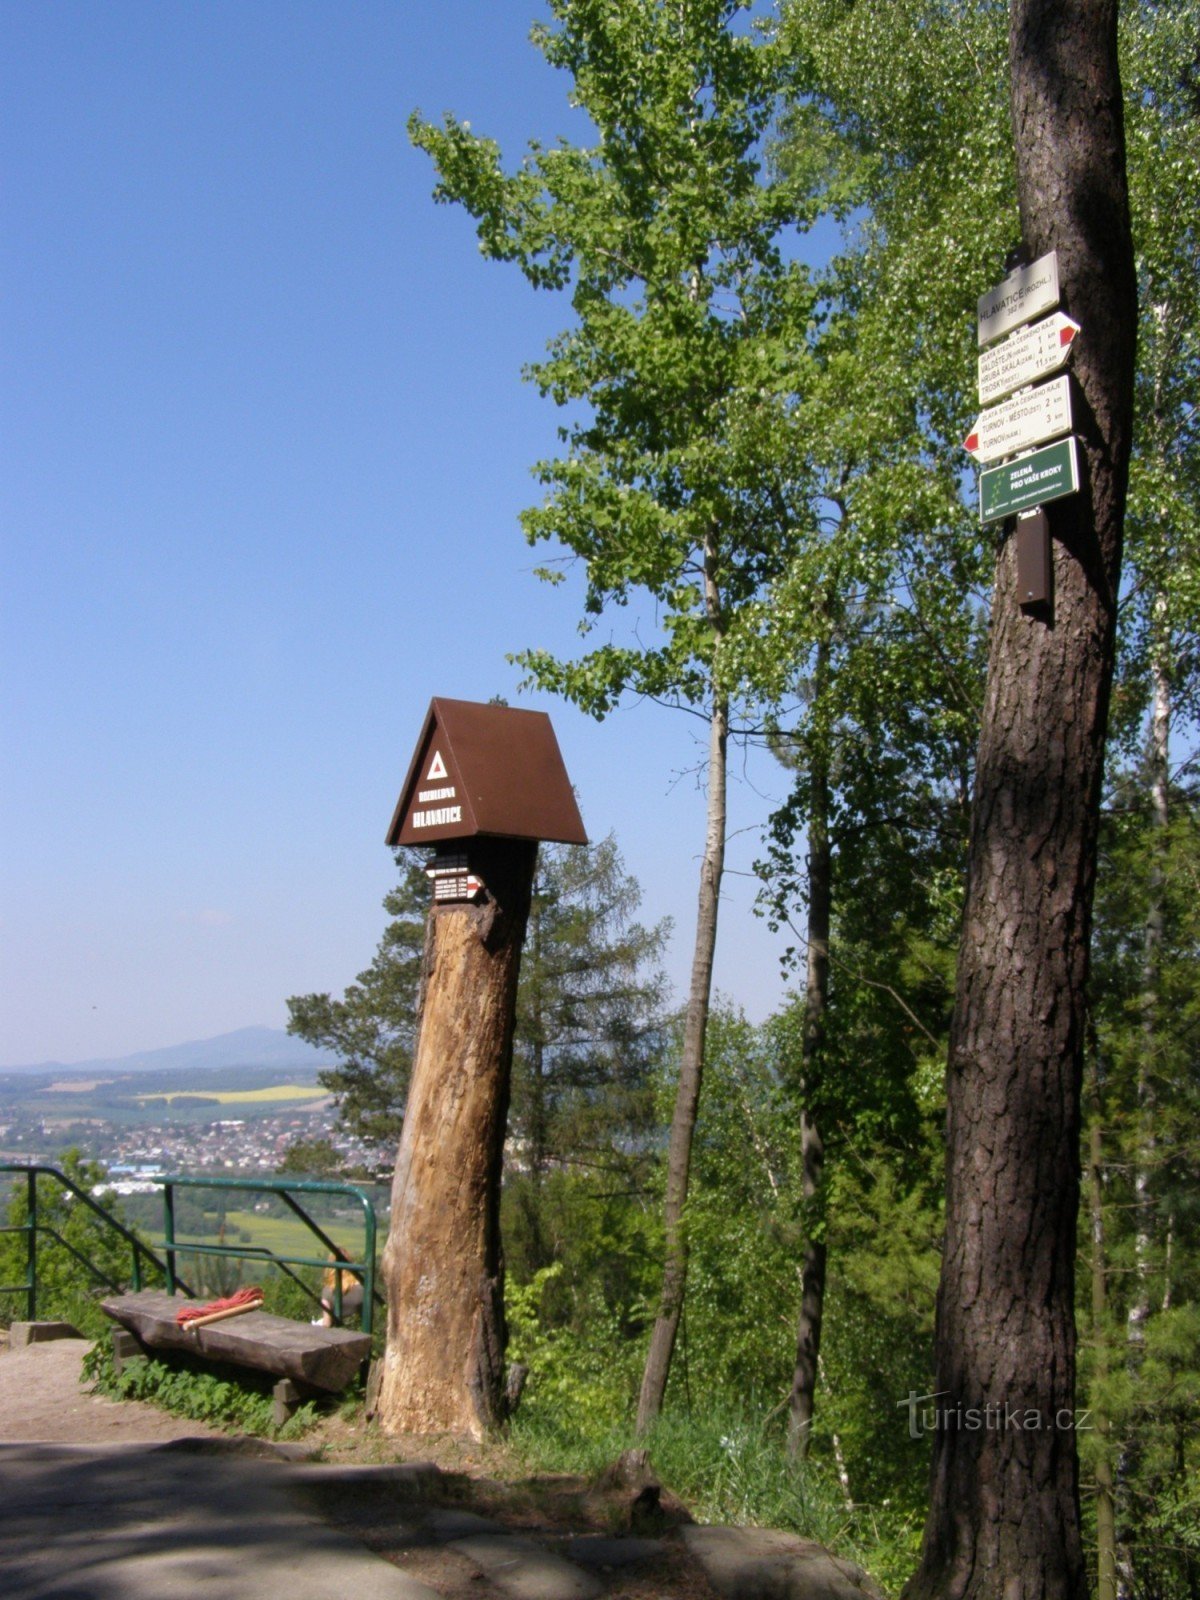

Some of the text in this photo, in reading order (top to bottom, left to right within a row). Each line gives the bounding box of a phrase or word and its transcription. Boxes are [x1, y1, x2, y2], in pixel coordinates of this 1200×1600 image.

[980, 288, 1024, 322] HLAVATICE
[982, 417, 1004, 434] TURNOV
[1045, 398, 1050, 408] 2
[983, 433, 1005, 449] TURNOV
[1046, 414, 1051, 424] 3
[1009, 464, 1032, 480] ZELENÁ
[1010, 464, 1062, 490] PRO VAŠE KROKY
